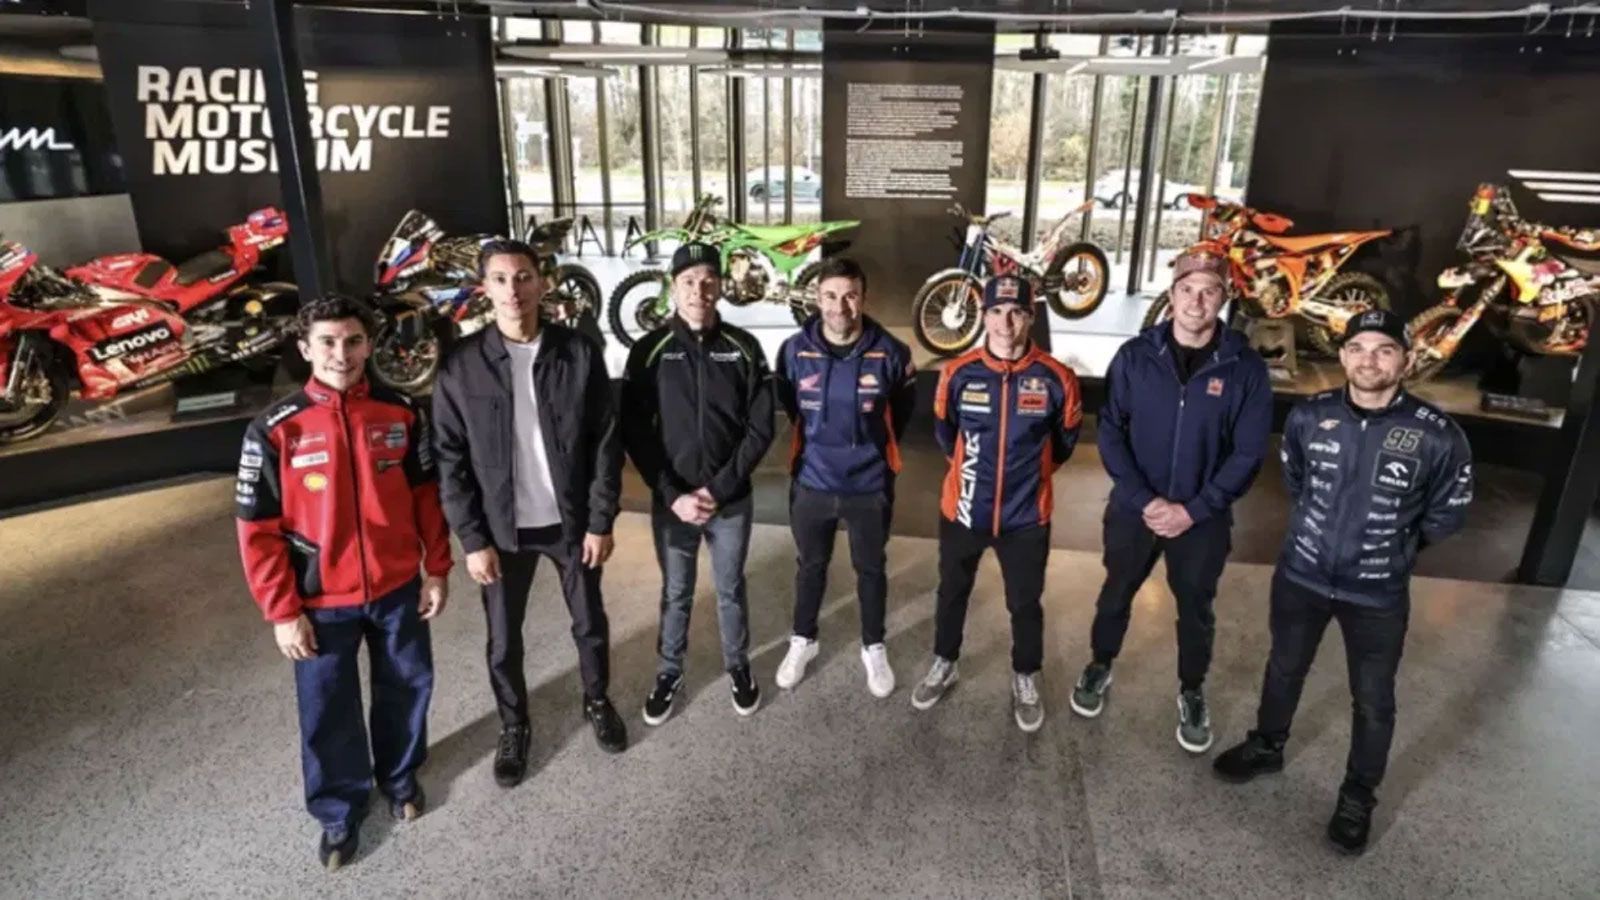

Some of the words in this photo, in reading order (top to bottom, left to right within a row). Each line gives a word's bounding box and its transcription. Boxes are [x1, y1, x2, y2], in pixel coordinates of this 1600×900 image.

[153, 139, 372, 175] MUSM
[92, 327, 170, 360] Lenovo
[1383, 427, 1424, 453] 95
